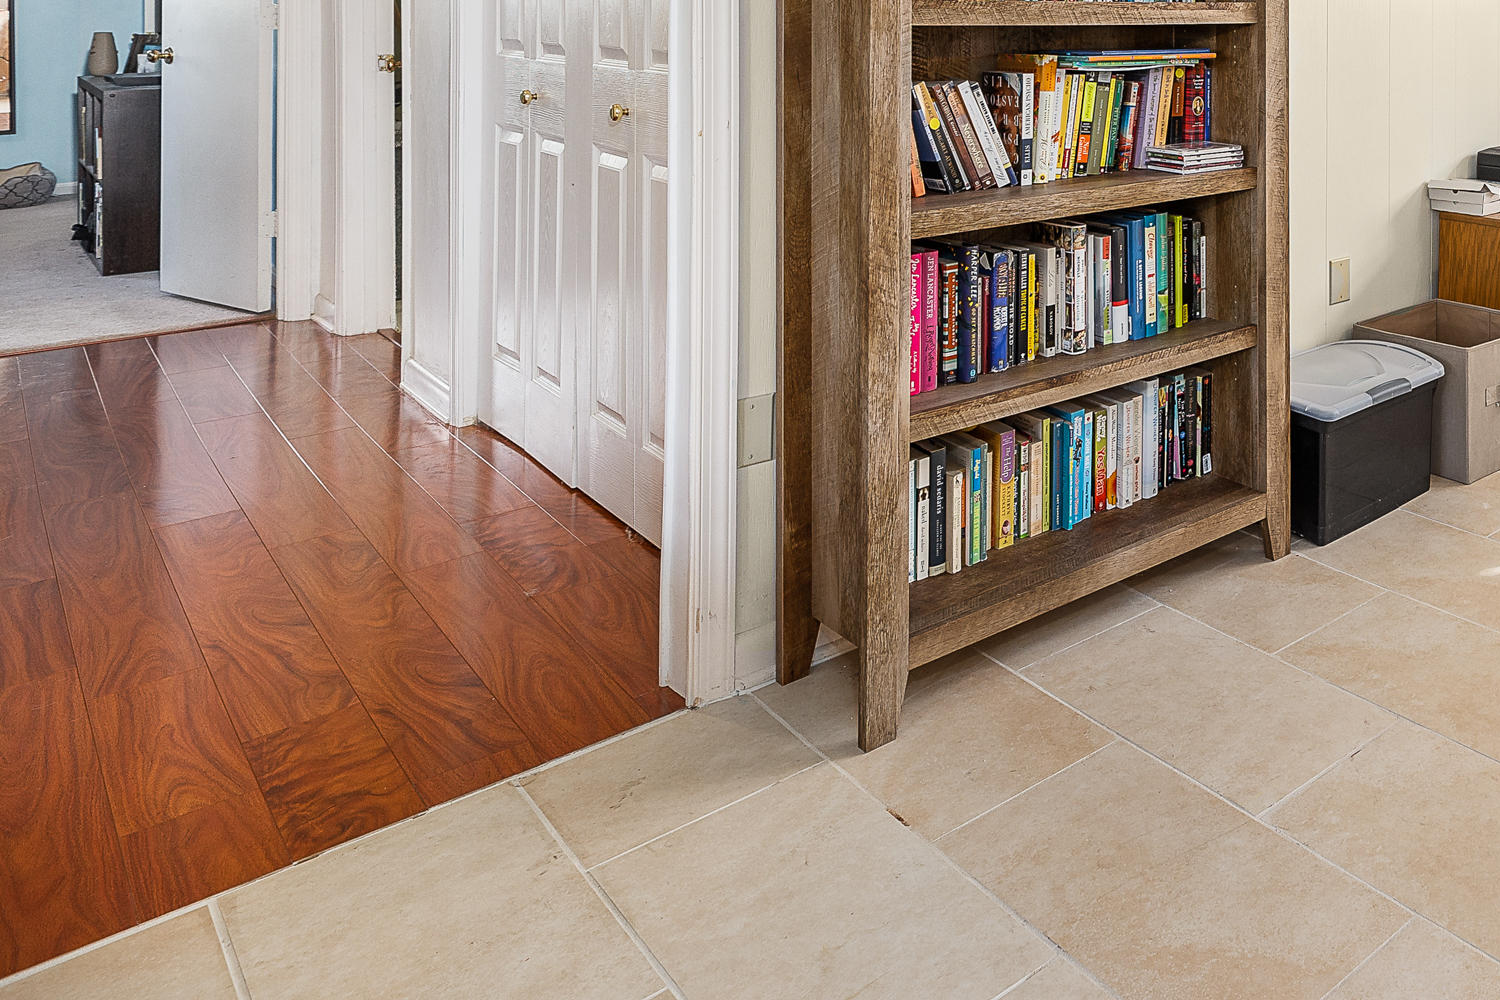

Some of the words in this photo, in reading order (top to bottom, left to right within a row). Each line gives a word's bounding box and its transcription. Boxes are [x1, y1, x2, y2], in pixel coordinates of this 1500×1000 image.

[961, 123, 985, 169] Neverwhere
[1077, 136, 1085, 161] Gaiman
[911, 258, 919, 273] Jen
[970, 249, 978, 281] HARPER
[910, 274, 920, 310] Lancaster
[926, 273, 934, 320] LANCASTER
[970, 285, 978, 299] LEE
[1002, 457, 1010, 478] Help
[1097, 446, 1106, 468] Yes
[1096, 469, 1106, 497] Man
